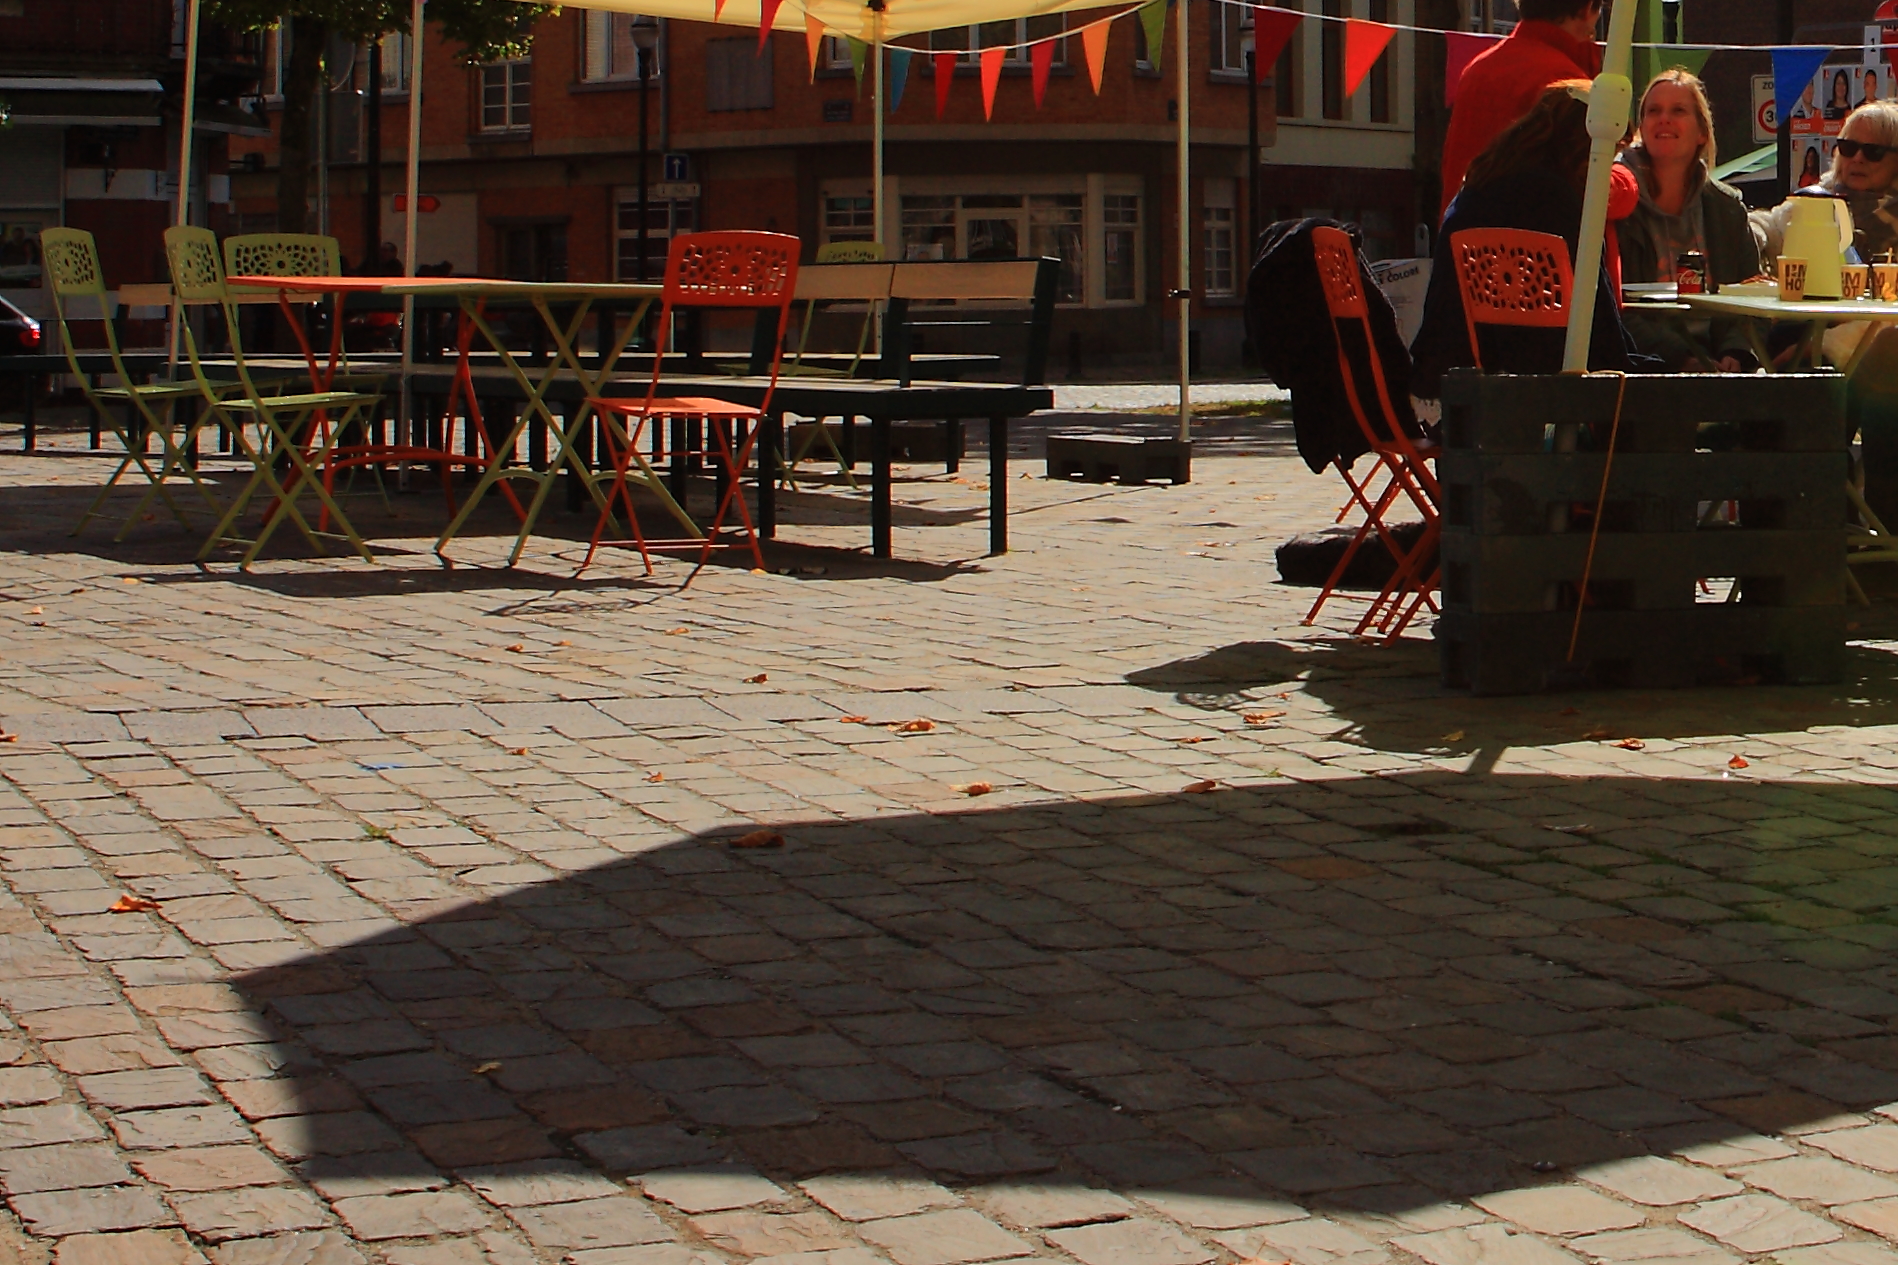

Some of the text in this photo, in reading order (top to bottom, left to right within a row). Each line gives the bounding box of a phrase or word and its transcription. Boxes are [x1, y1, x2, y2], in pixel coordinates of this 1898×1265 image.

[1870, 38, 1876, 52] 1
[1762, 82, 1774, 90] ZO
[1766, 110, 1776, 123] 3
[1785, 278, 1806, 291] HO
[1842, 286, 1860, 297] OT
